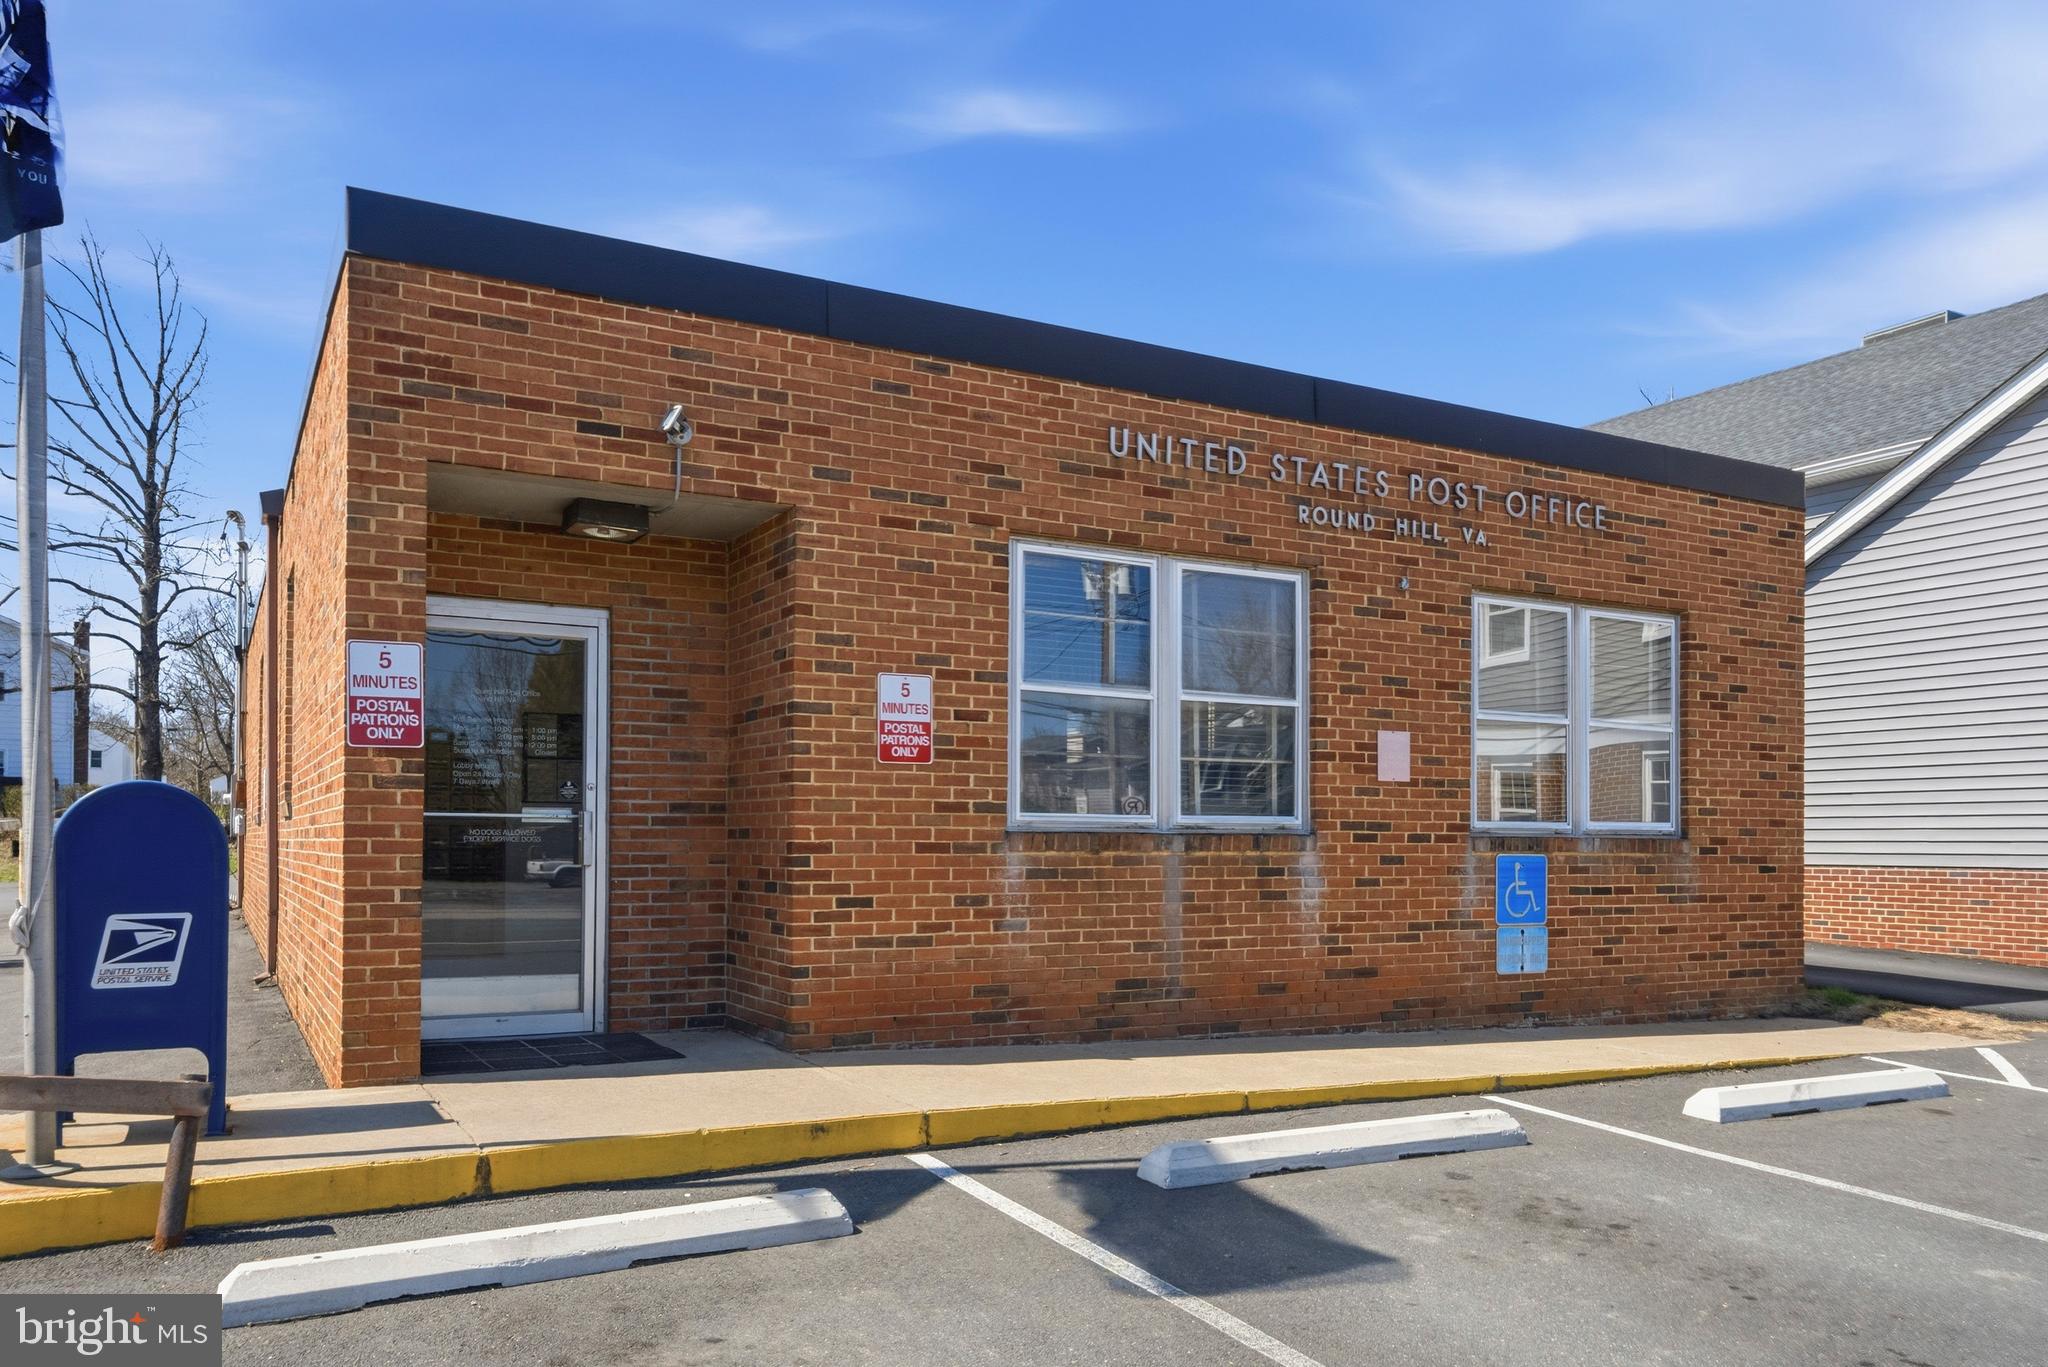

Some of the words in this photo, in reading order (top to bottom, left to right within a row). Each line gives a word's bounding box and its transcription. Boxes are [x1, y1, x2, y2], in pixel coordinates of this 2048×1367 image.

[17, 167, 47, 184] YOU
[1109, 426, 1247, 476] UNITED
[1269, 453, 1390, 498] STATES
[1409, 473, 1488, 512] POST
[1504, 491, 1608, 530] OFFICE
[1297, 504, 1376, 531] ROUND
[1462, 526, 1492, 547] VA.
[378, 651, 392, 669] 5
[352, 674, 418, 690] MINUTES
[900, 683, 911, 698] 5
[356, 699, 415, 713] POSTAL
[882, 702, 929, 715] MINUTES
[351, 712, 419, 727] PATRONS
[366, 727, 405, 740] ONLY
[884, 722, 927, 735] POSTAL
[880, 734, 930, 746] PATRONS
[891, 746, 919, 758] ONLY
[468, 828, 480, 836] NO
[502, 828, 536, 836] ALLOWED
[98, 967, 136, 976] UNITED
[136, 966, 169, 975] STATES
[96, 976, 133, 985] POSTAL
[133, 973, 172, 984] SERVICE
